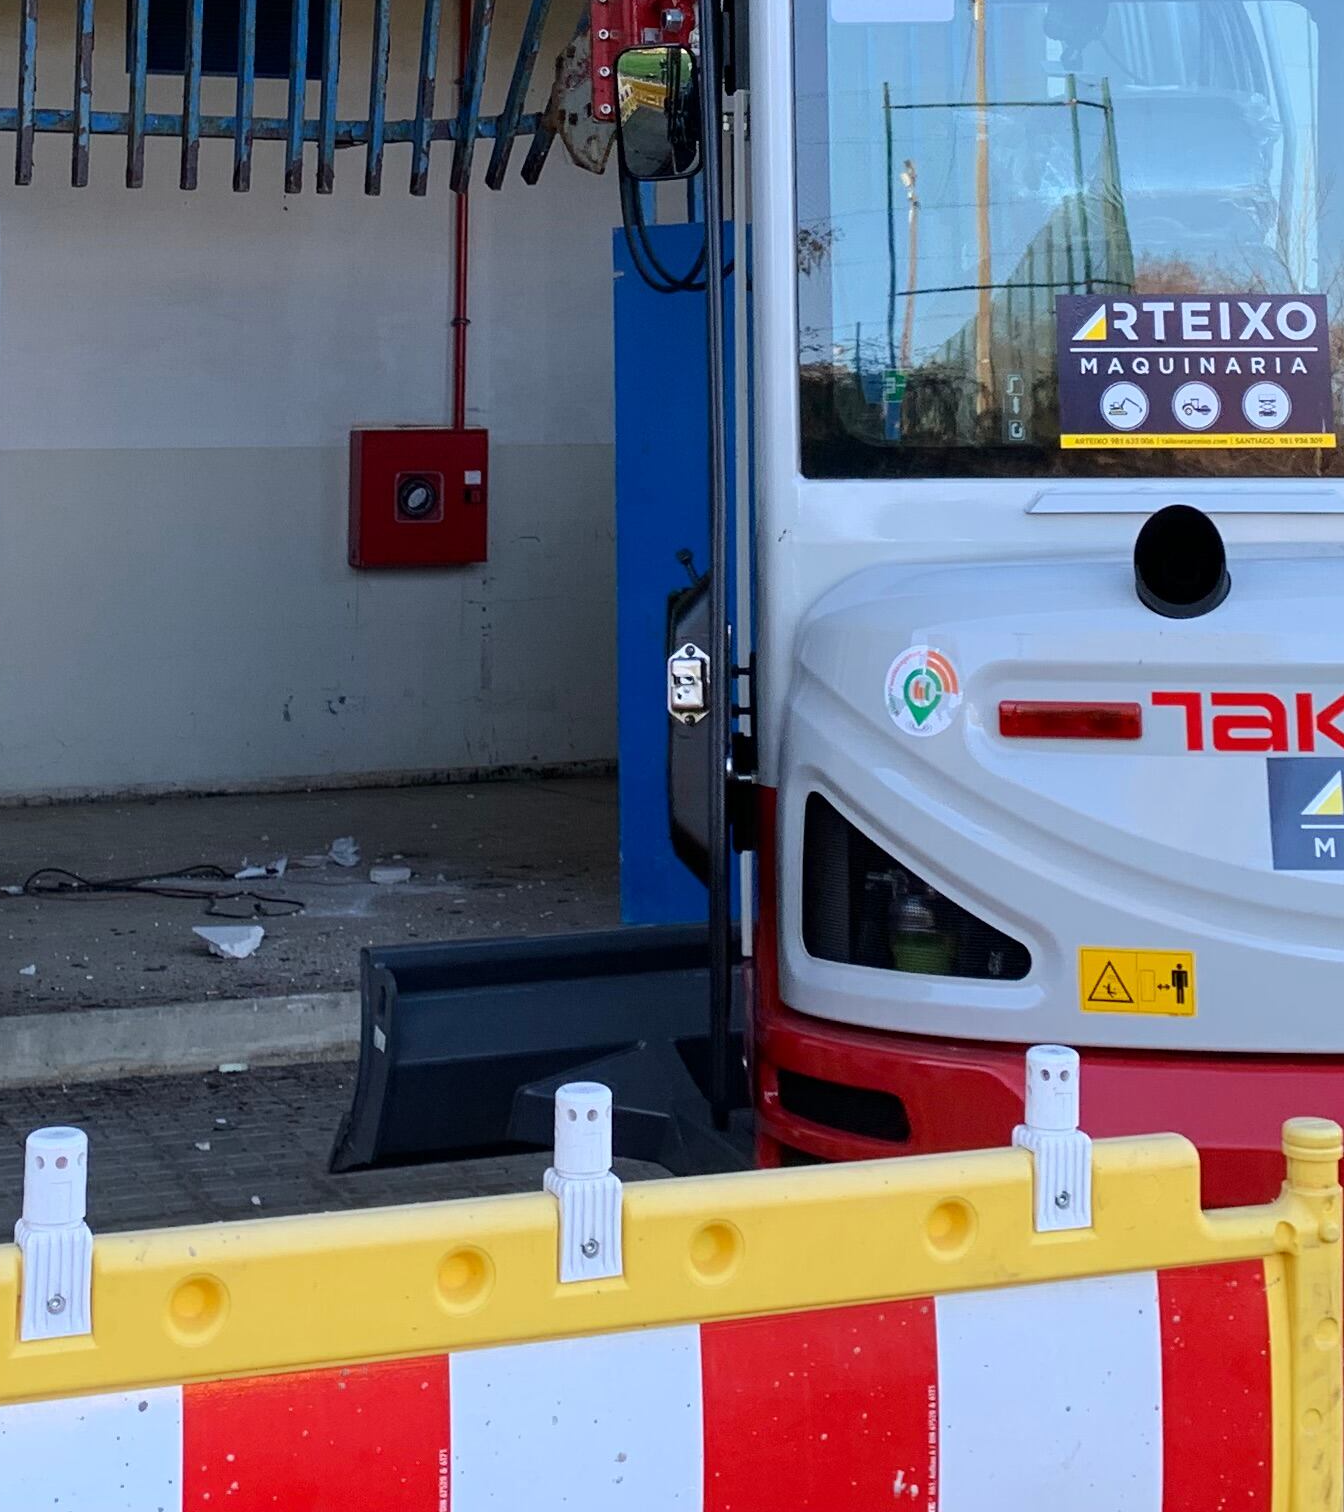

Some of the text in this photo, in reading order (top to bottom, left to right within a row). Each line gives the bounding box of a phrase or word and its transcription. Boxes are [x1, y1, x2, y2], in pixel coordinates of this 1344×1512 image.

[1072, 301, 1317, 341] ARTEIXO
[1080, 356, 1308, 375] MAQUINARIA
[1235, 437, 1275, 445] SANTIAGO
